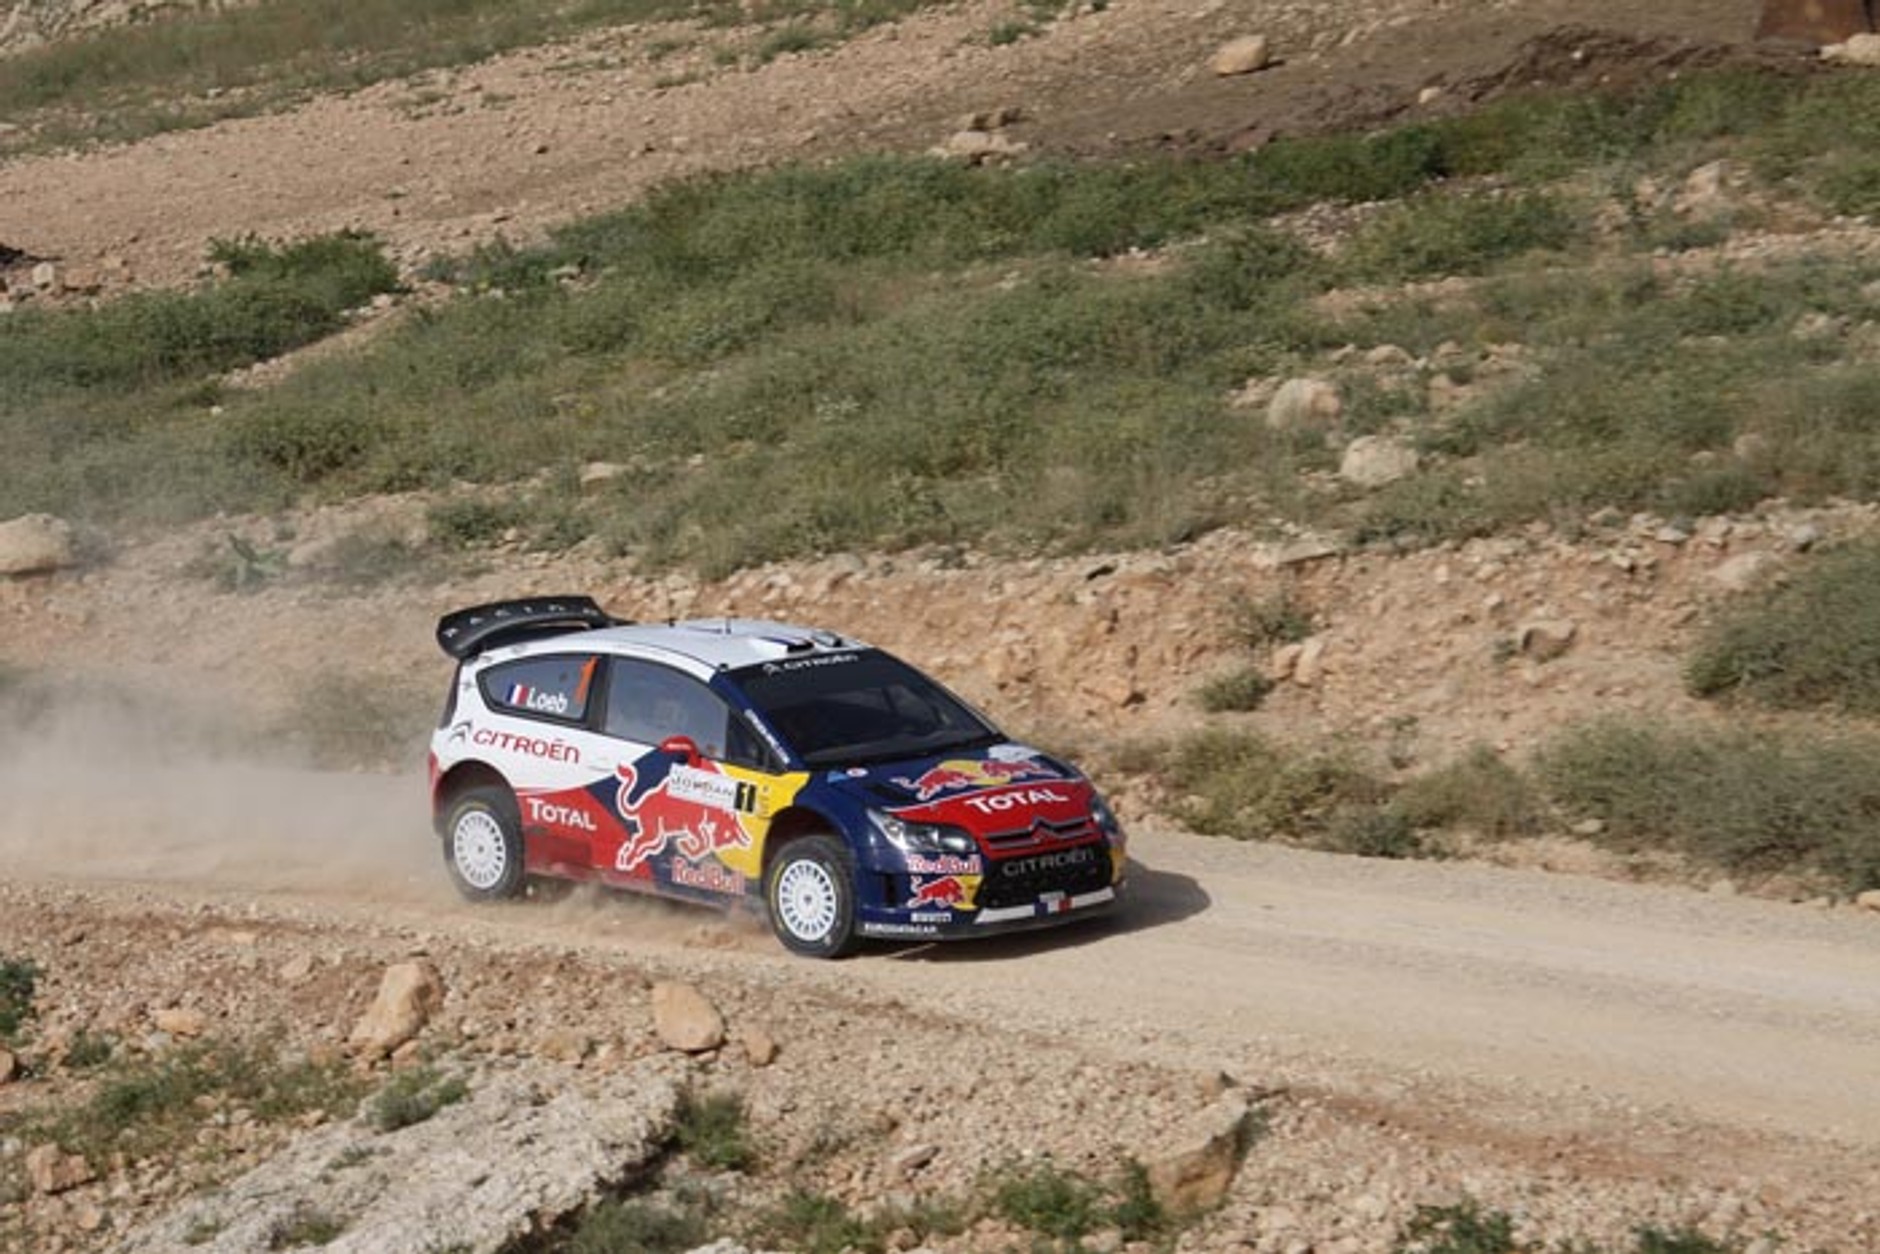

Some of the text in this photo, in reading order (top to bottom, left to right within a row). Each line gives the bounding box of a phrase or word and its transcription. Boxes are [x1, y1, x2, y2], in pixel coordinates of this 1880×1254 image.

[575, 655, 599, 705] 1
[526, 687, 568, 713] Loeb
[526, 797, 597, 832] TOTAL
[965, 788, 1069, 814] TOTAL
